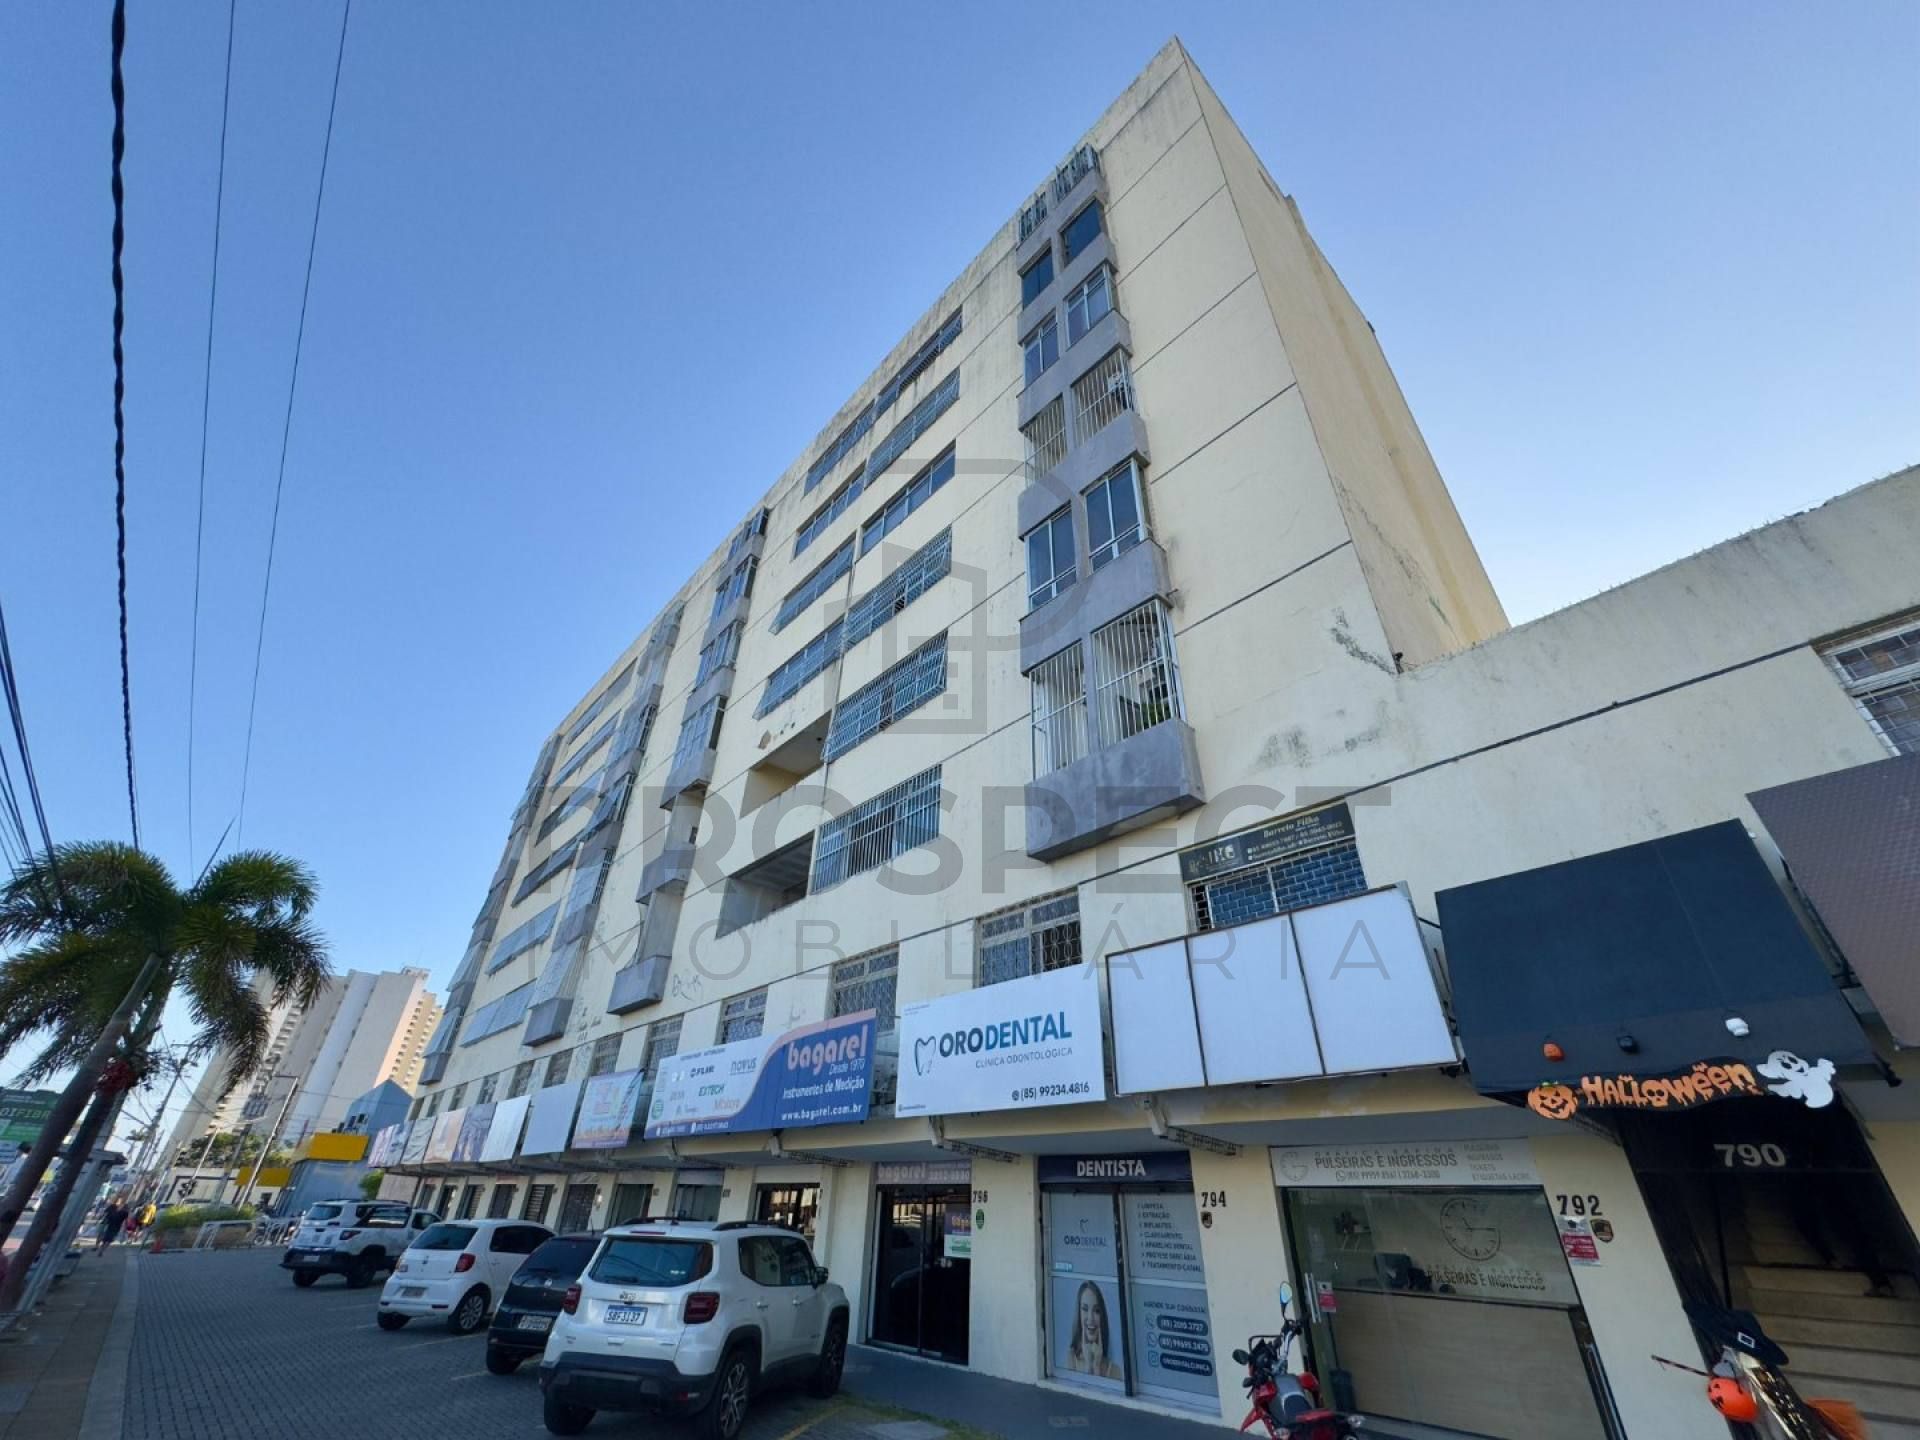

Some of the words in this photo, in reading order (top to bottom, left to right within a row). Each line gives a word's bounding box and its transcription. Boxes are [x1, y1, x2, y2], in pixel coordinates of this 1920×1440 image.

[939, 1012, 1073, 1058] ORODENTAL
[787, 1024, 868, 1076] bagarel
[975, 1054, 1005, 1069] CLÍNICA
[1007, 1047, 1073, 1065] ODONTOLÓGICA
[782, 1081, 823, 1099] Instrumentos
[824, 1081, 834, 1094] de
[835, 1075, 865, 1095] Medição
[1020, 1085, 1037, 1102] (85)
[1039, 1081, 1090, 1097] 99234.4816
[781, 1104, 864, 1120] www.bagarel.com.br
[1314, 1153, 1374, 1169] PULSEIRAS
[1376, 1153, 1385, 1168] E
[1387, 1152, 1457, 1168] INGRESSOS
[1713, 1142, 1787, 1168] 790
[1076, 1159, 1147, 1177] DENTISTA
[1201, 1190, 1227, 1208] 794
[1557, 1194, 1603, 1216] 792
[1063, 1234, 1107, 1247] ORODENTAL
